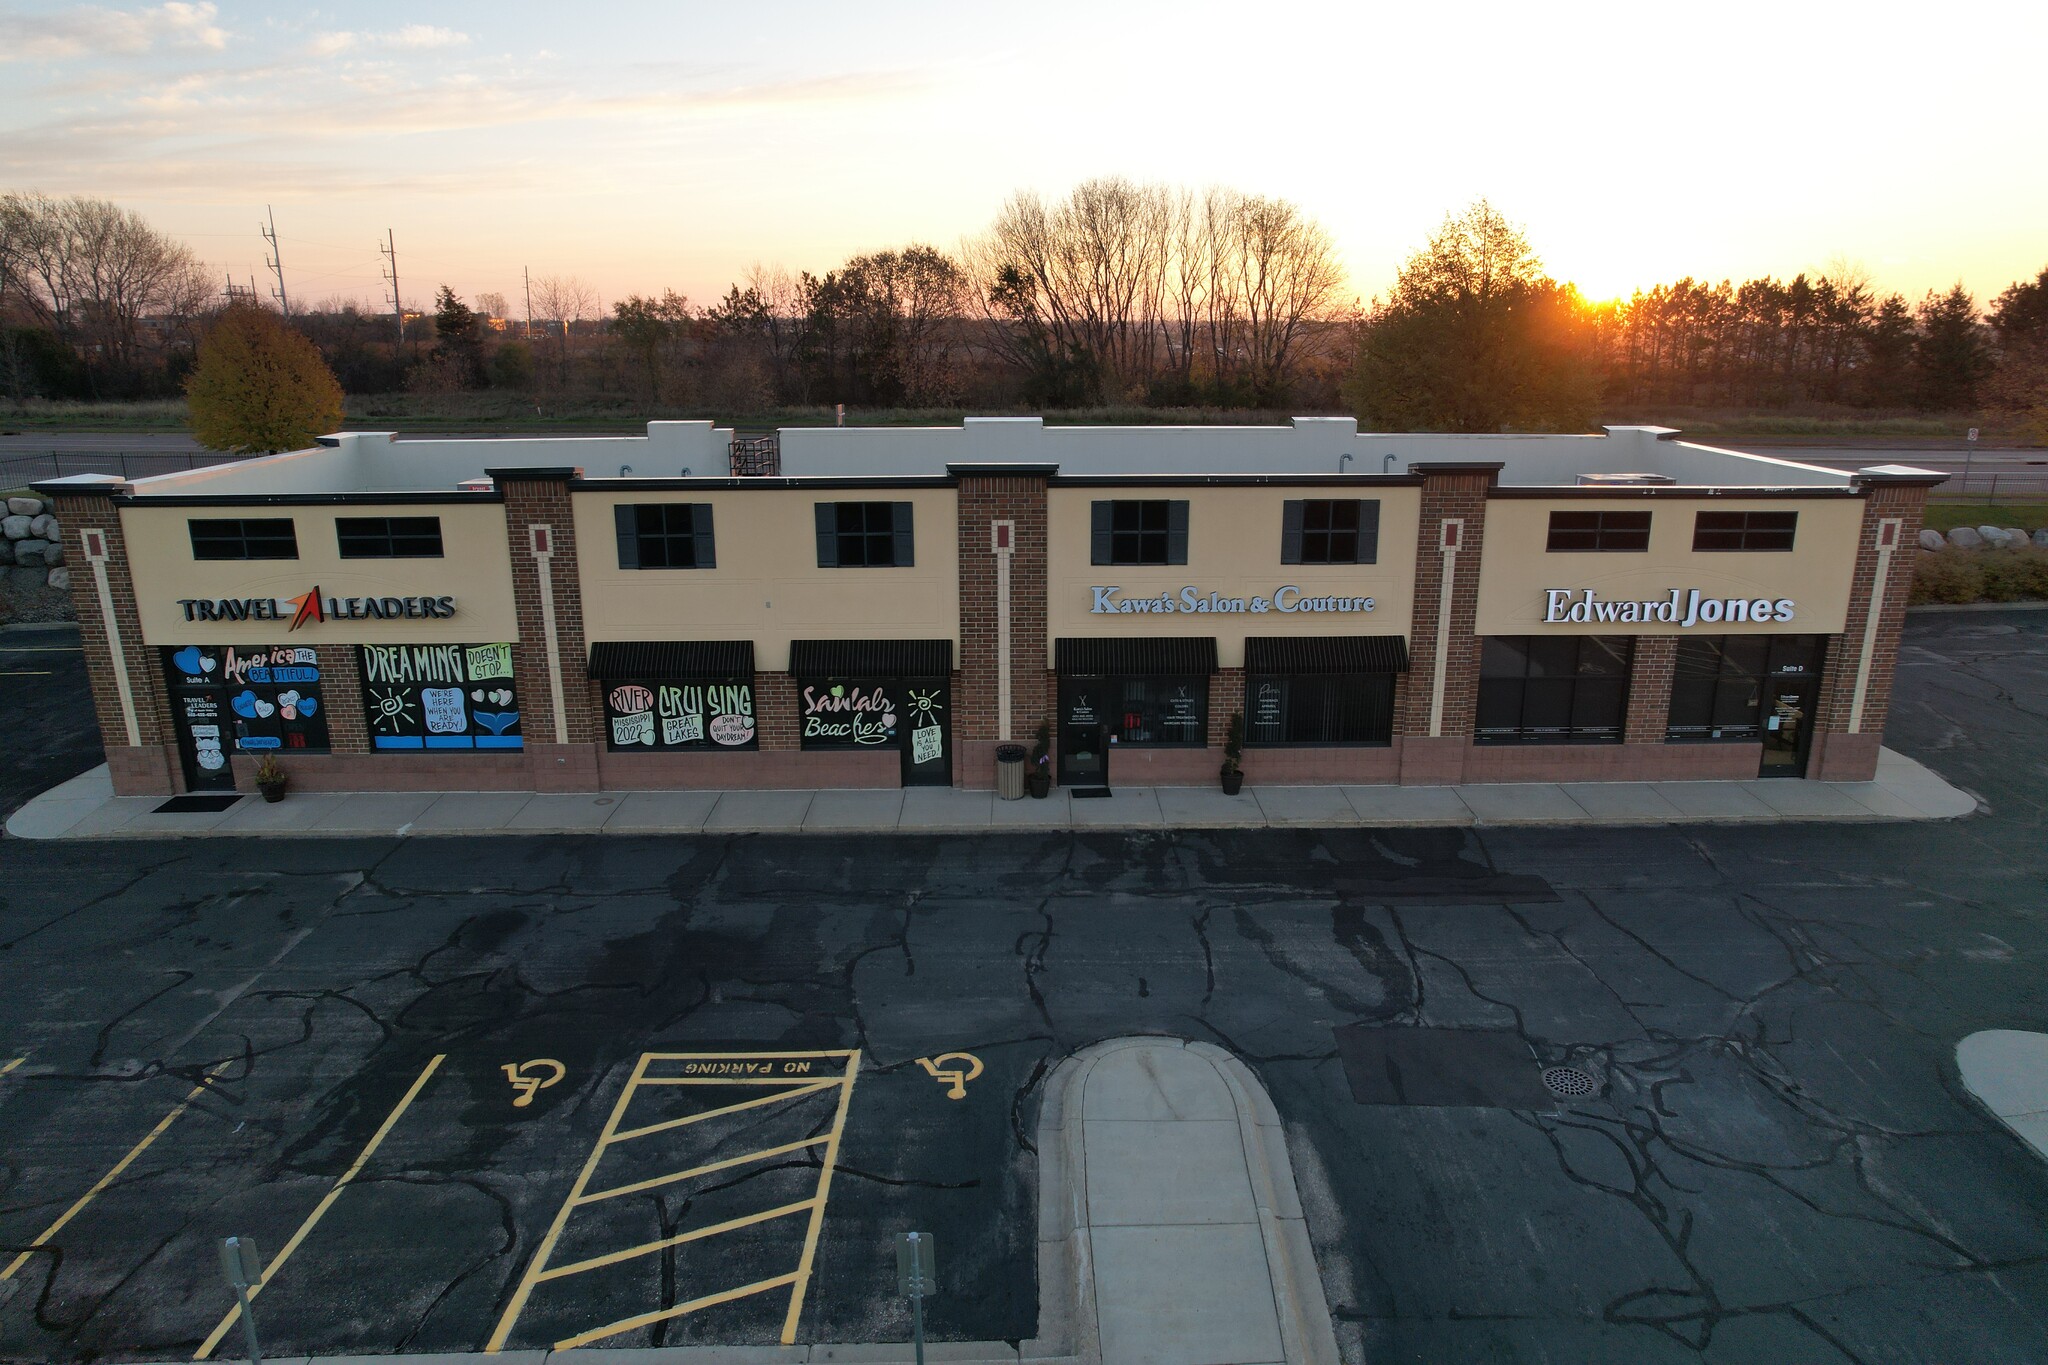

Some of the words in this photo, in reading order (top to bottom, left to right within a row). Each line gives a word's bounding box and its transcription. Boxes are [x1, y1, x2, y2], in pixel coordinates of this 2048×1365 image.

[1090, 586, 1175, 614] Kawa's
[1179, 586, 1246, 614] Salon
[1249, 596, 1269, 613] &
[1274, 585, 1376, 613] Couture
[177, 598, 287, 622] TRAVEL
[328, 596, 457, 620] LEADERS
[1543, 588, 1680, 623] Edward
[1680, 588, 1796, 627] Jones
[468, 645, 509, 666] DOESN'T
[224, 646, 295, 685] America
[296, 650, 313, 661] THE
[363, 645, 464, 683] DREAMING
[186, 676, 203, 684] Suite
[204, 676, 211, 684] A
[251, 667, 314, 681] BEAUTIFUL!
[432, 698, 454, 706] HERE
[611, 689, 650, 712] RIVER
[658, 685, 752, 717] CRUISING
[427, 707, 449, 715] WHEN
[449, 707, 461, 715] YOU
[430, 720, 463, 731] READY!
[613, 714, 651, 727] MISSISSIPPI
[666, 715, 698, 731] GREAT
[722, 716, 741, 724] DON'T
[712, 724, 729, 732] QUIT
[729, 723, 745, 732] YOUR
[804, 711, 888, 745] Beaches
[917, 728, 936, 739] LOVE
[669, 728, 699, 742] LAKES
[924, 736, 937, 744] ALL
[917, 744, 940, 761] NEED!
[921, 744, 934, 752] YOU
[685, 1062, 773, 1074] PARKING
[784, 1062, 811, 1074] NO
